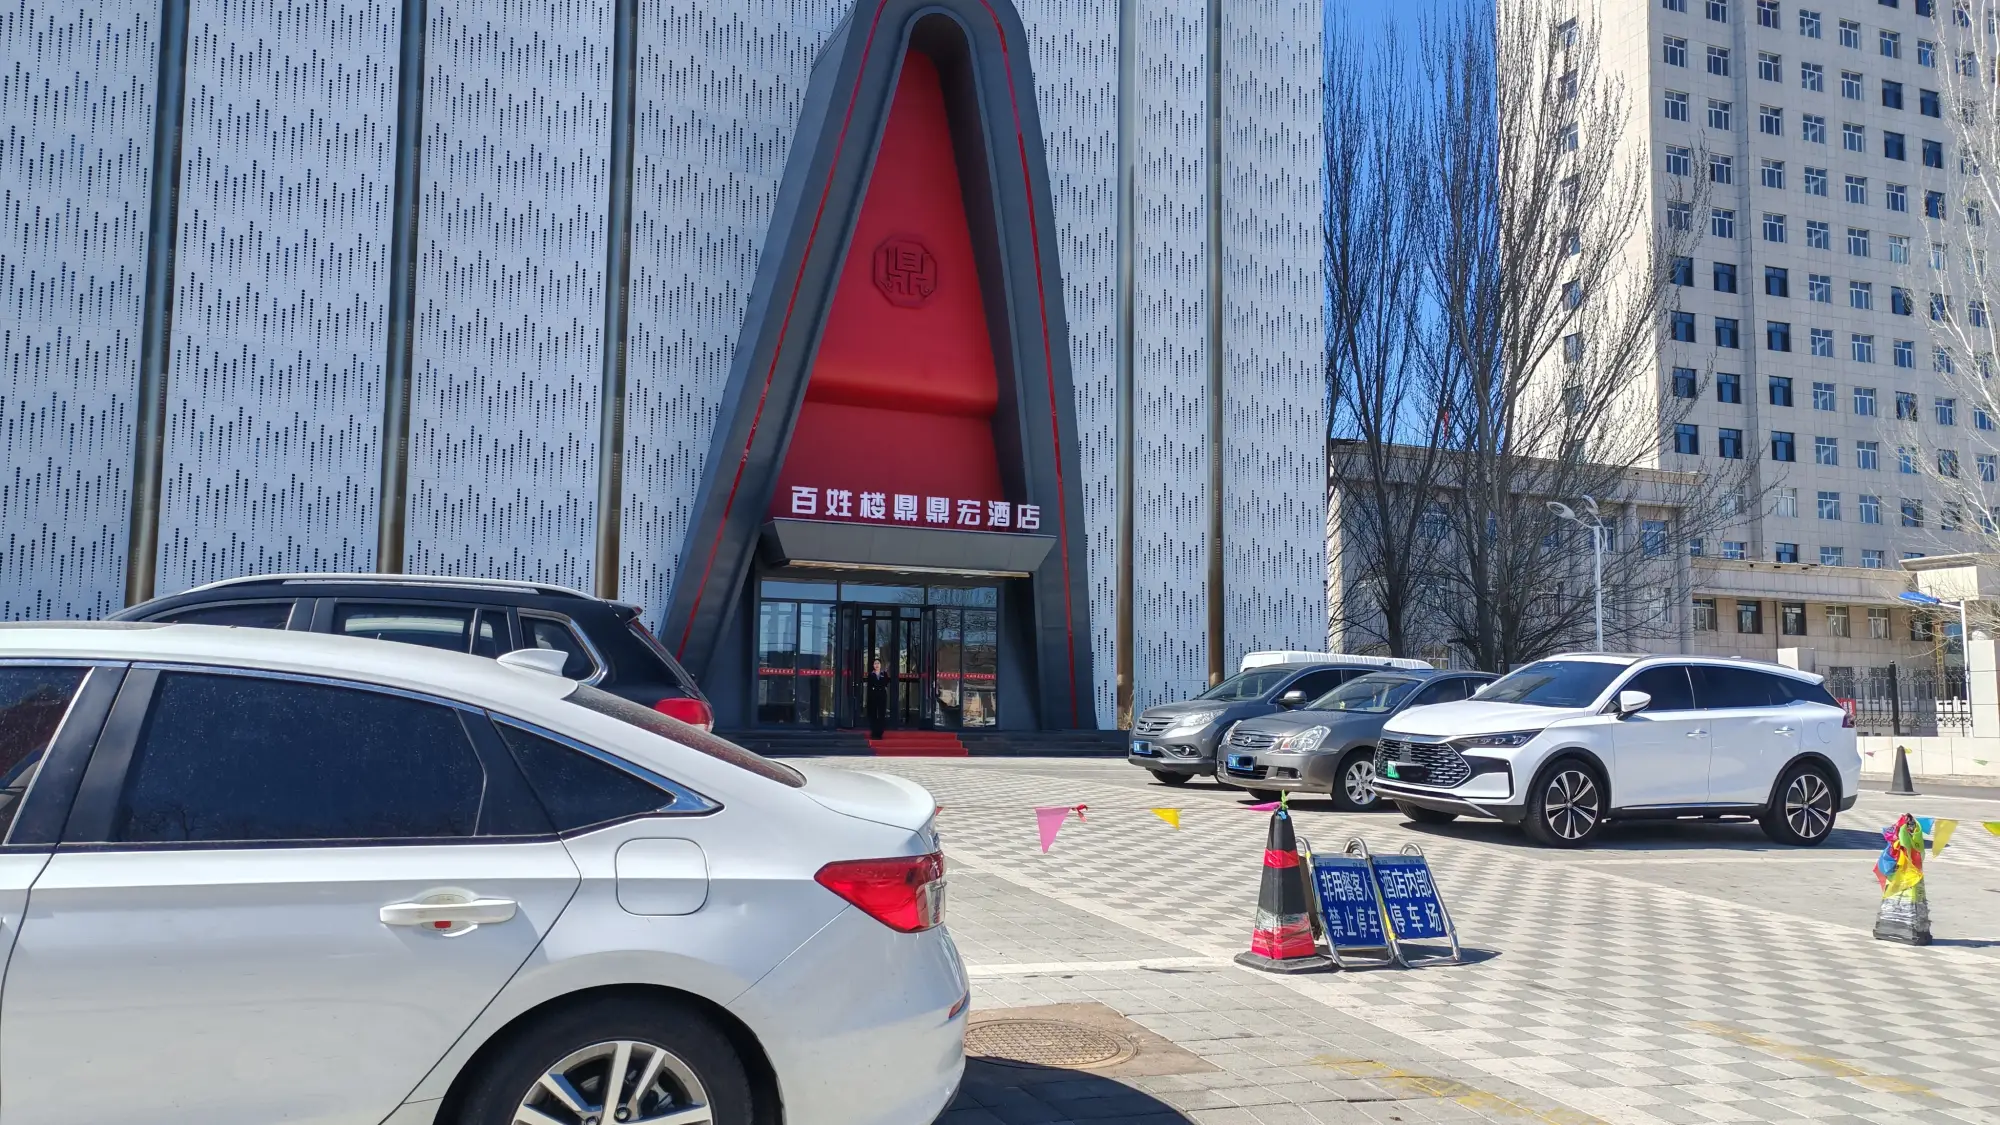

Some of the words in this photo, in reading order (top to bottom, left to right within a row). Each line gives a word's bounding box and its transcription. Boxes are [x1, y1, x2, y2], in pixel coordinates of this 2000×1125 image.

[791, 485, 1041, 530] 百姓楼鼎鼎宏酒店
[1320, 869, 1375, 902] 非用餐客人
[1378, 868, 1433, 900] 酒店内部
[1327, 905, 1381, 939] 禁止停车
[1389, 901, 1443, 934] 停车场
